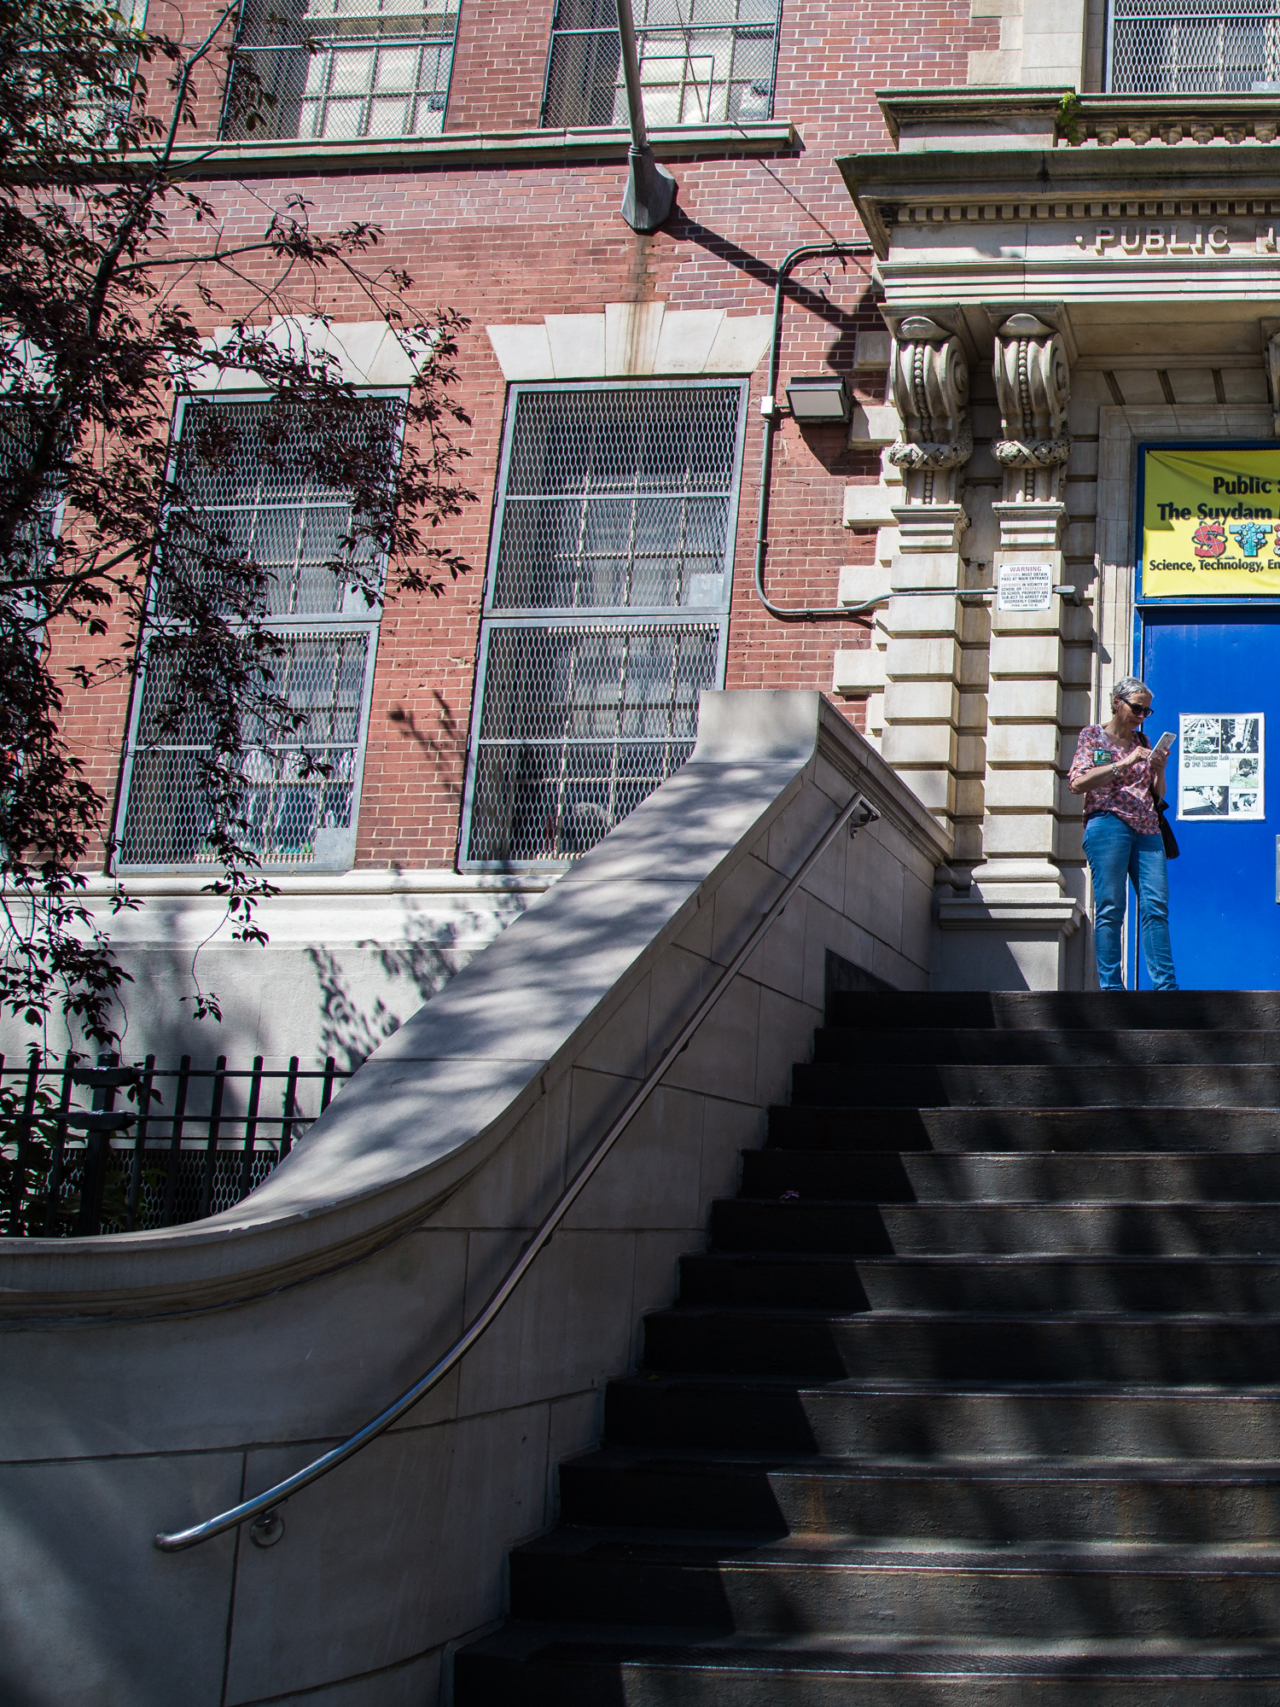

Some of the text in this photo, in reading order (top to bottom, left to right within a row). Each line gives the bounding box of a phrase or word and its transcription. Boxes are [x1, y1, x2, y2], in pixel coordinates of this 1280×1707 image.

[1095, 223, 1231, 253] PUBLIC
[1213, 476, 1271, 495] Public
[1157, 502, 1191, 520] The
[1197, 502, 1272, 524] Suydam
[1149, 560, 1196, 572] Science,
[1198, 559, 1264, 573] Technology,
